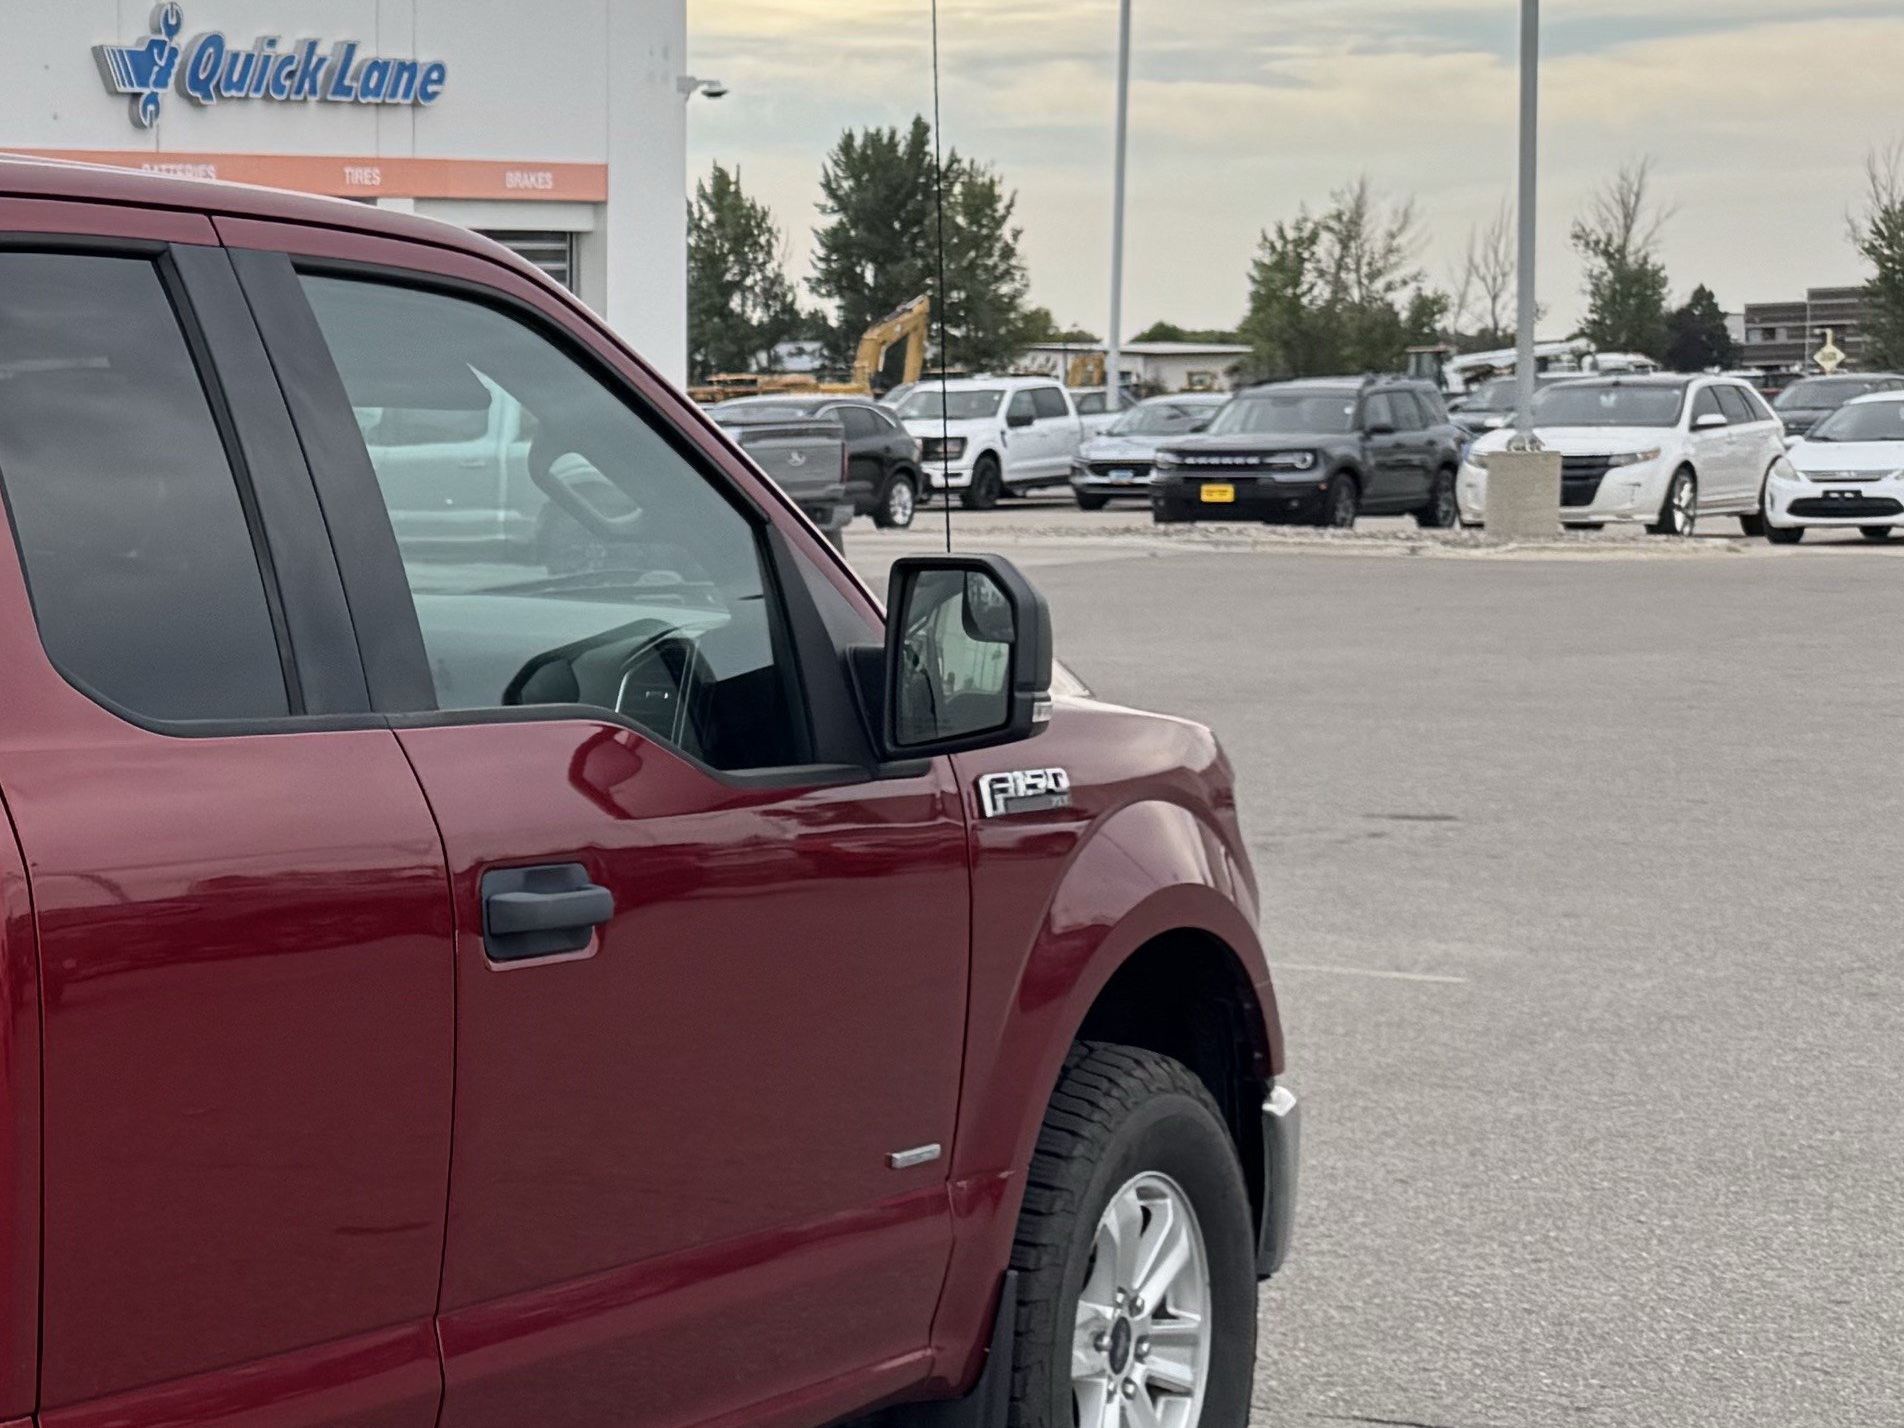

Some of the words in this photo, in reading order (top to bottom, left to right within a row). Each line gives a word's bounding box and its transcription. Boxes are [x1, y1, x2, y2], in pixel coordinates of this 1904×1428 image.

[186, 31, 326, 105] Quick
[327, 39, 446, 105] Lane
[343, 166, 382, 186] TIRES
[505, 172, 553, 189] BRAKES
